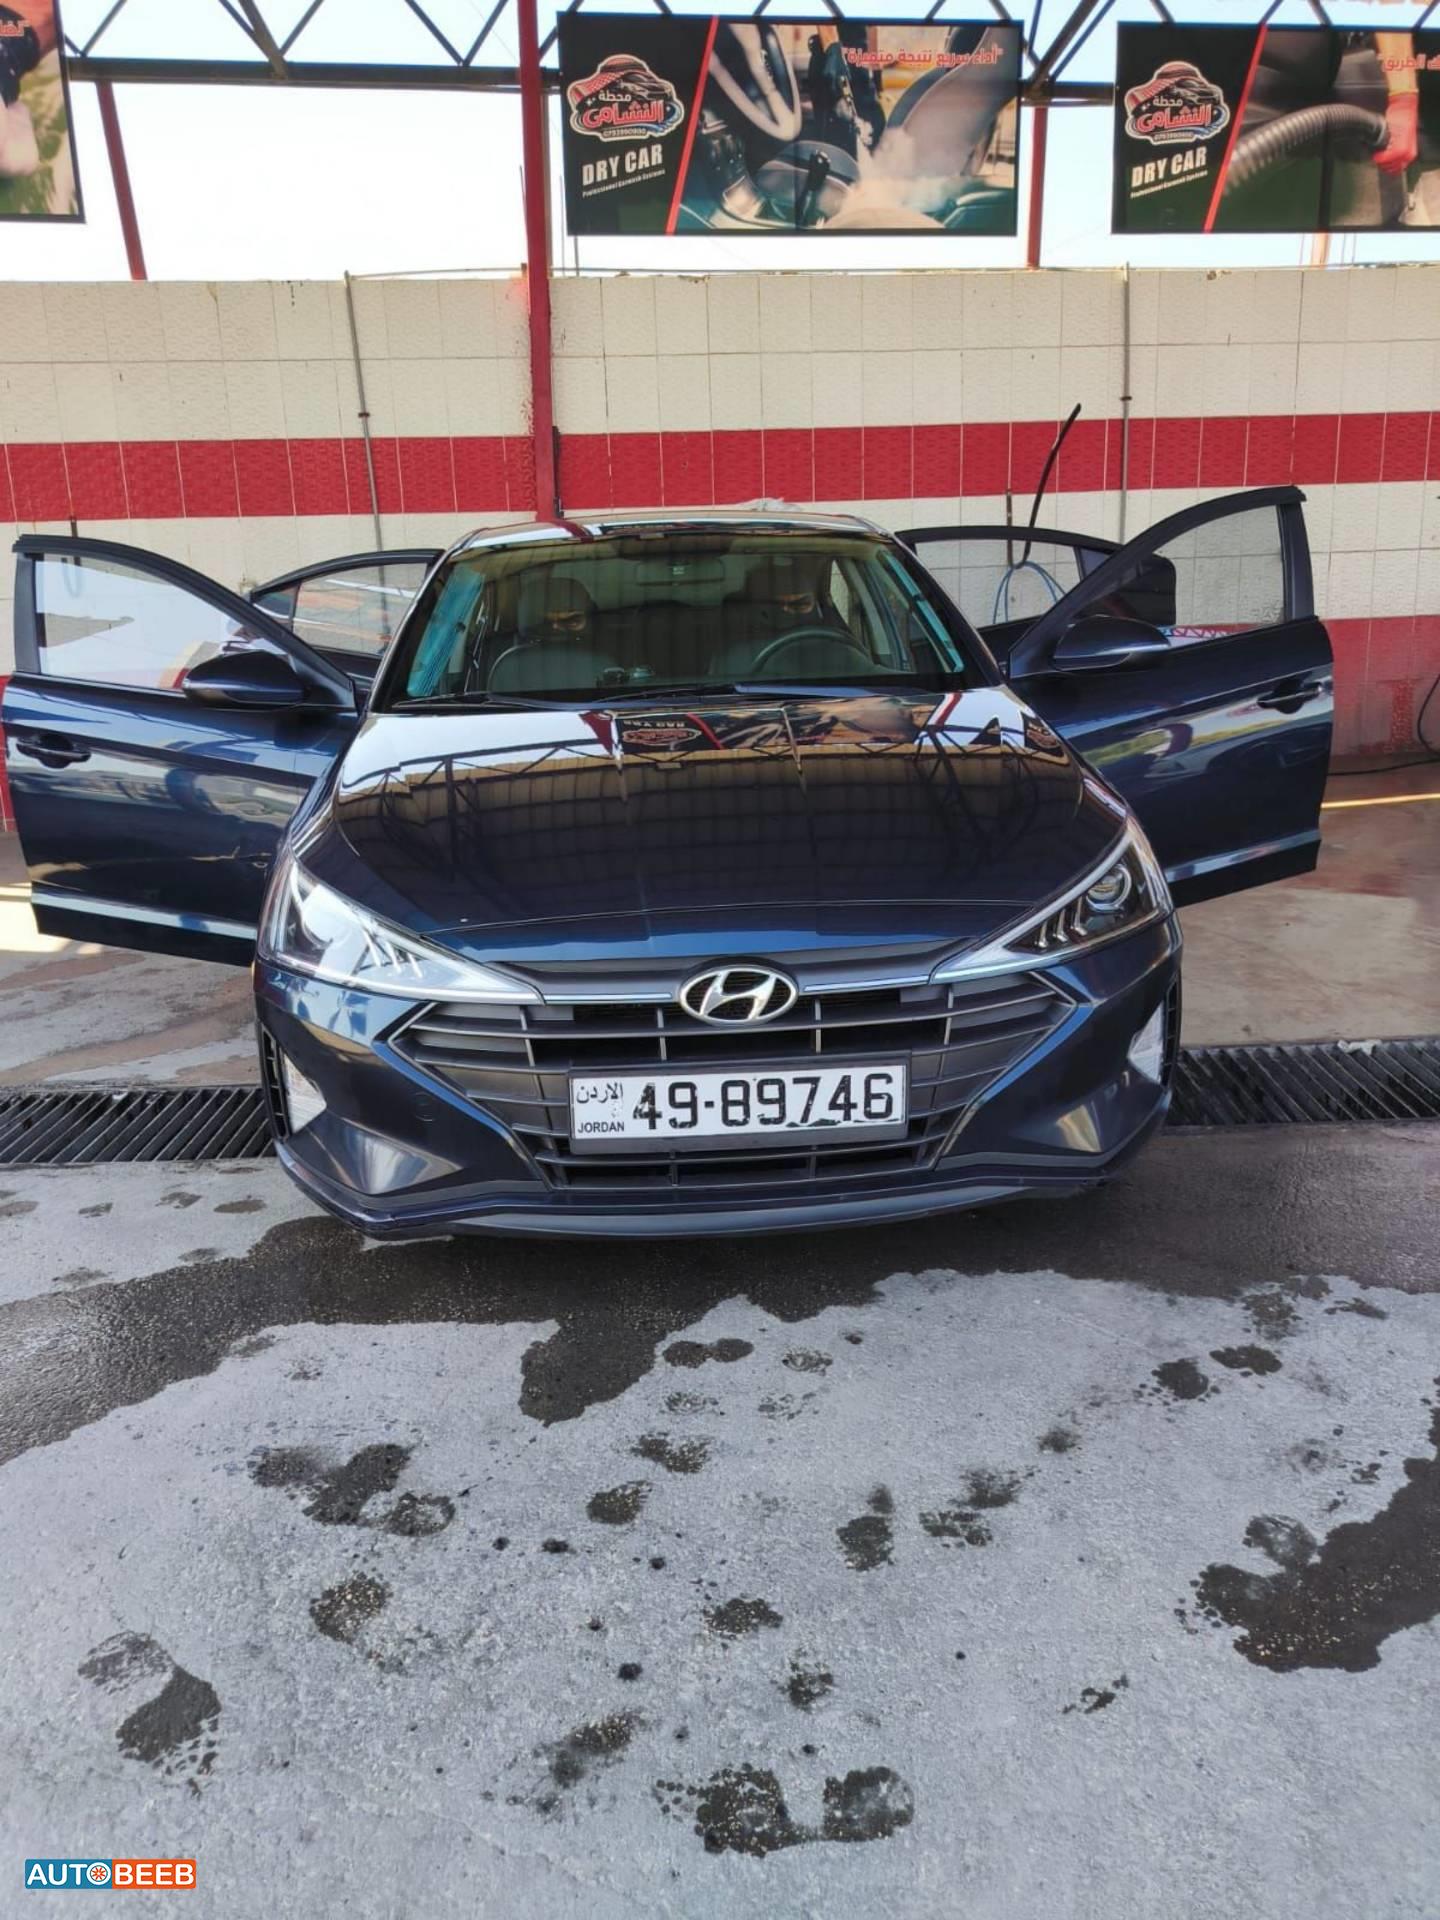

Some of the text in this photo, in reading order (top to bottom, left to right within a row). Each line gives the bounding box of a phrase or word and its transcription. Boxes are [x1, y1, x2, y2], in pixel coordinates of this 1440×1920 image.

[898, 48, 932, 66] نتيجة
[936, 50, 972, 67] سريع
[598, 89, 632, 101] محطة
[1152, 95, 1183, 107] محطة
[582, 143, 663, 187] DRY CAR
[1131, 157, 1168, 188] DRY
[1171, 146, 1207, 175] CAR
[576, 1082, 624, 1104] الاردن
[633, 1073, 894, 1130] 49-89746
[577, 1121, 625, 1134] JORDAN
